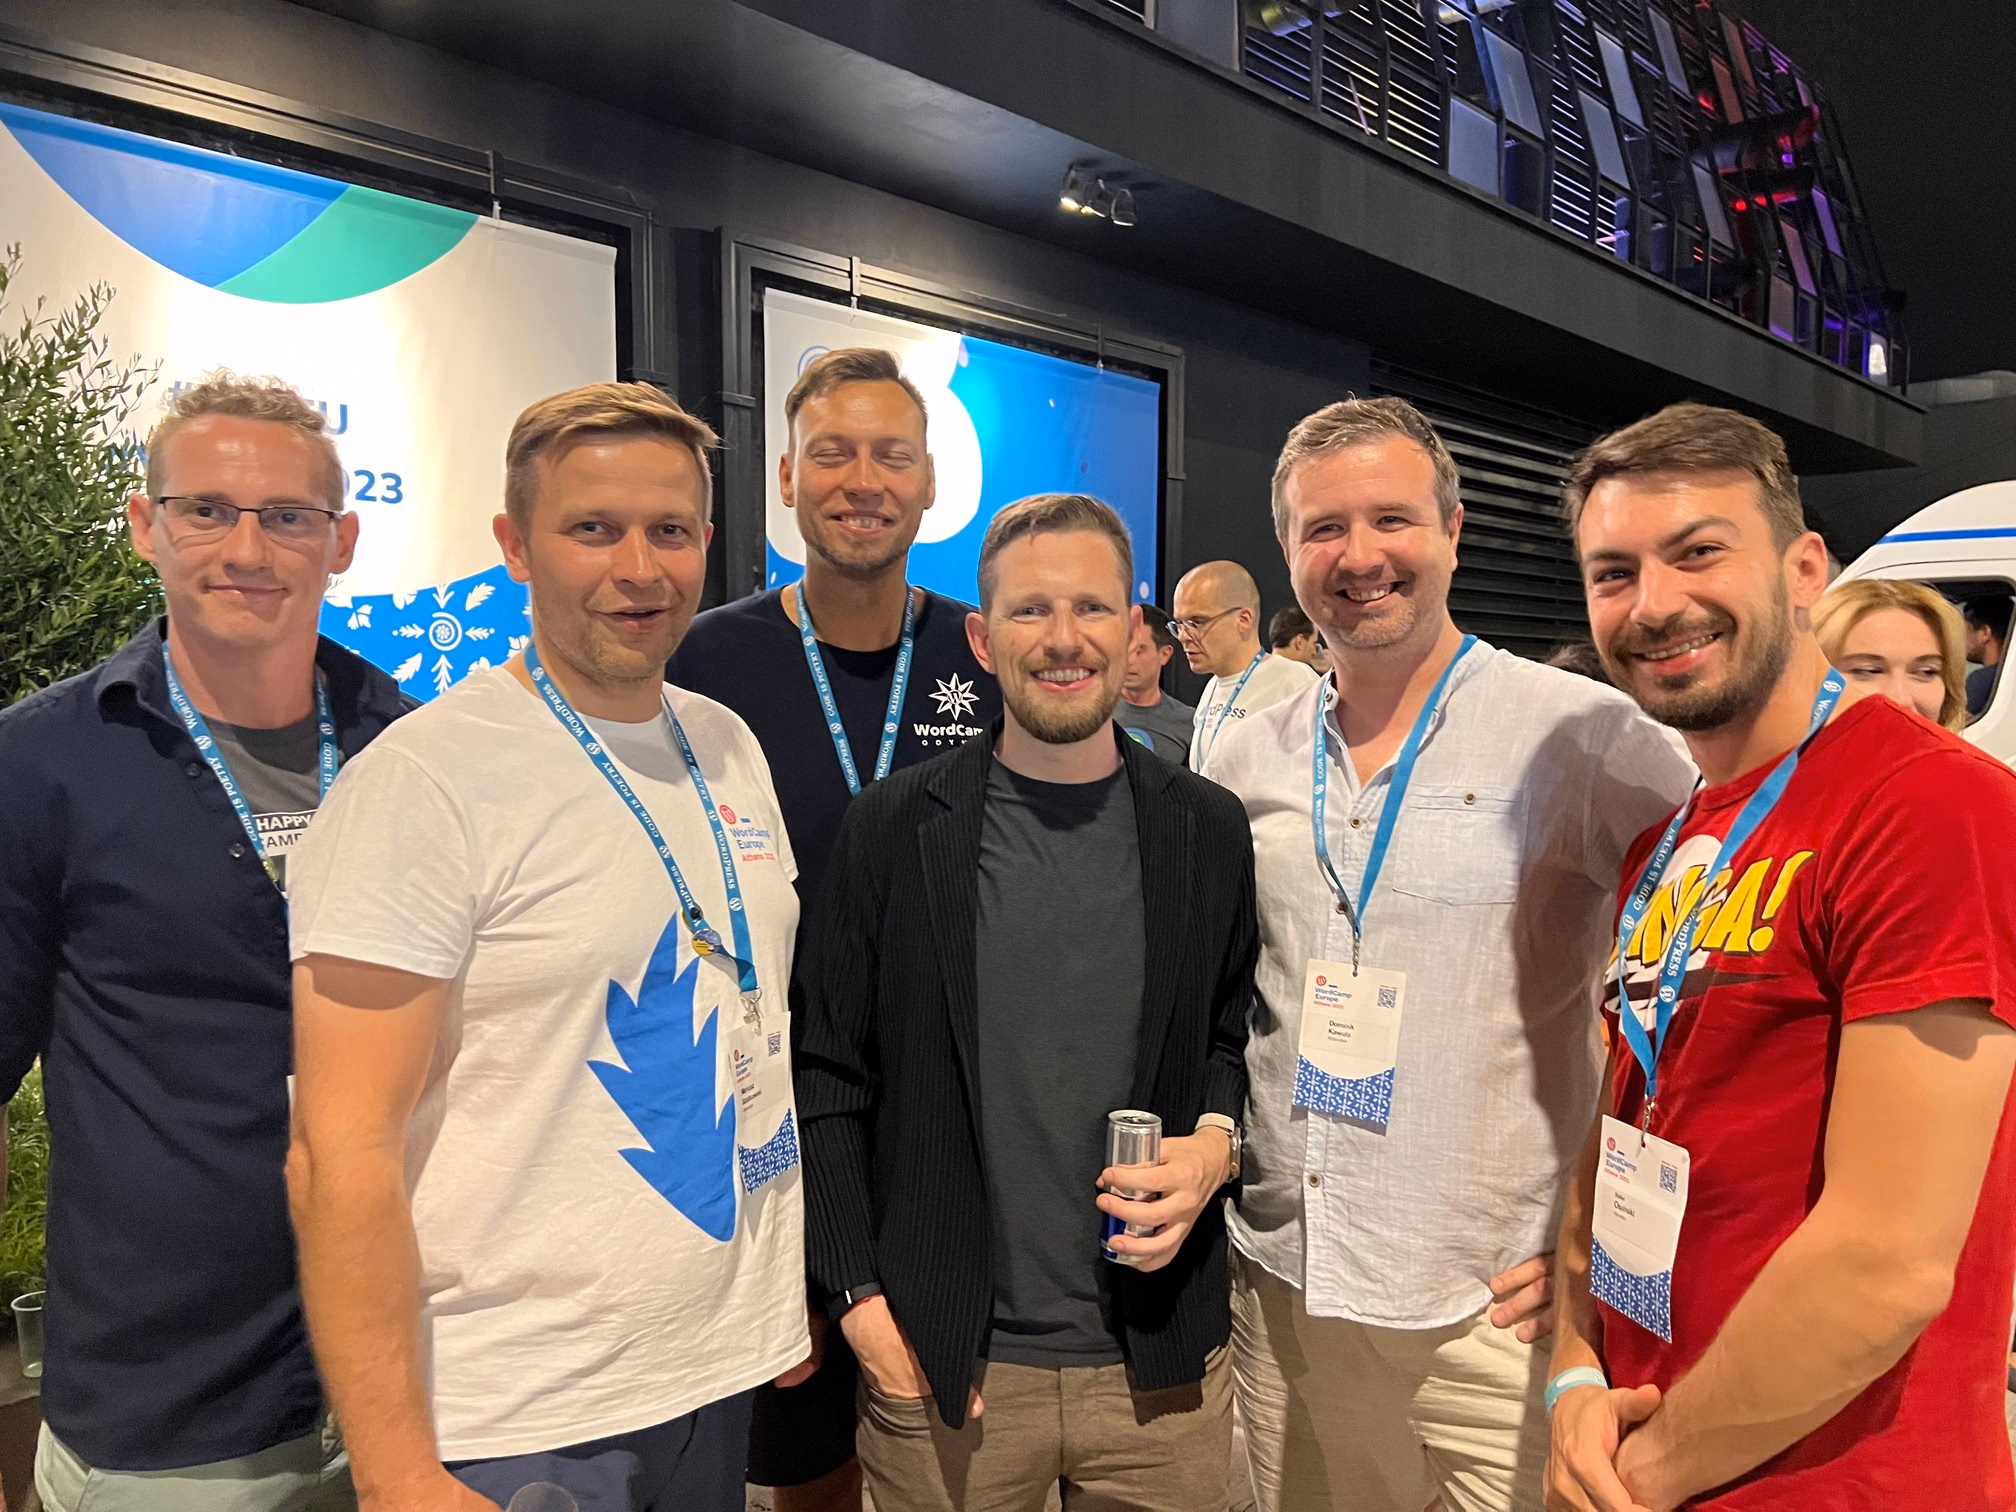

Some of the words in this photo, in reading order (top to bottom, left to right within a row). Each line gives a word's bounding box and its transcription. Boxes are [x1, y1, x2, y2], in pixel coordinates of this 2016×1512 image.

[343, 468, 404, 505] 23
[899, 651, 908, 673] CODE
[542, 683, 586, 738] WORDPRESS
[890, 683, 902, 717] POETRY
[323, 742, 333, 770] CODE
[837, 738, 857, 789] WORDPRESS
[874, 739, 893, 781] WORDPRE
[207, 756, 237, 797] POETRY
[601, 761, 633, 798] POETRY
[231, 797, 244, 809] IS
[630, 798, 642, 809] IS
[239, 811, 258, 842] CODE
[256, 814, 312, 831] HAPPY
[639, 810, 660, 839] CODE
[715, 830, 736, 890] WORDPRESS
[736, 839, 766, 851] Europe
[1653, 827, 1677, 869] POETRY
[1648, 872, 1659, 884] IS
[669, 865, 702, 927] WRDPRESS
[1633, 884, 1652, 911] CODE
[1314, 987, 1353, 999] WordCamp
[1314, 993, 1339, 1003] Europe
